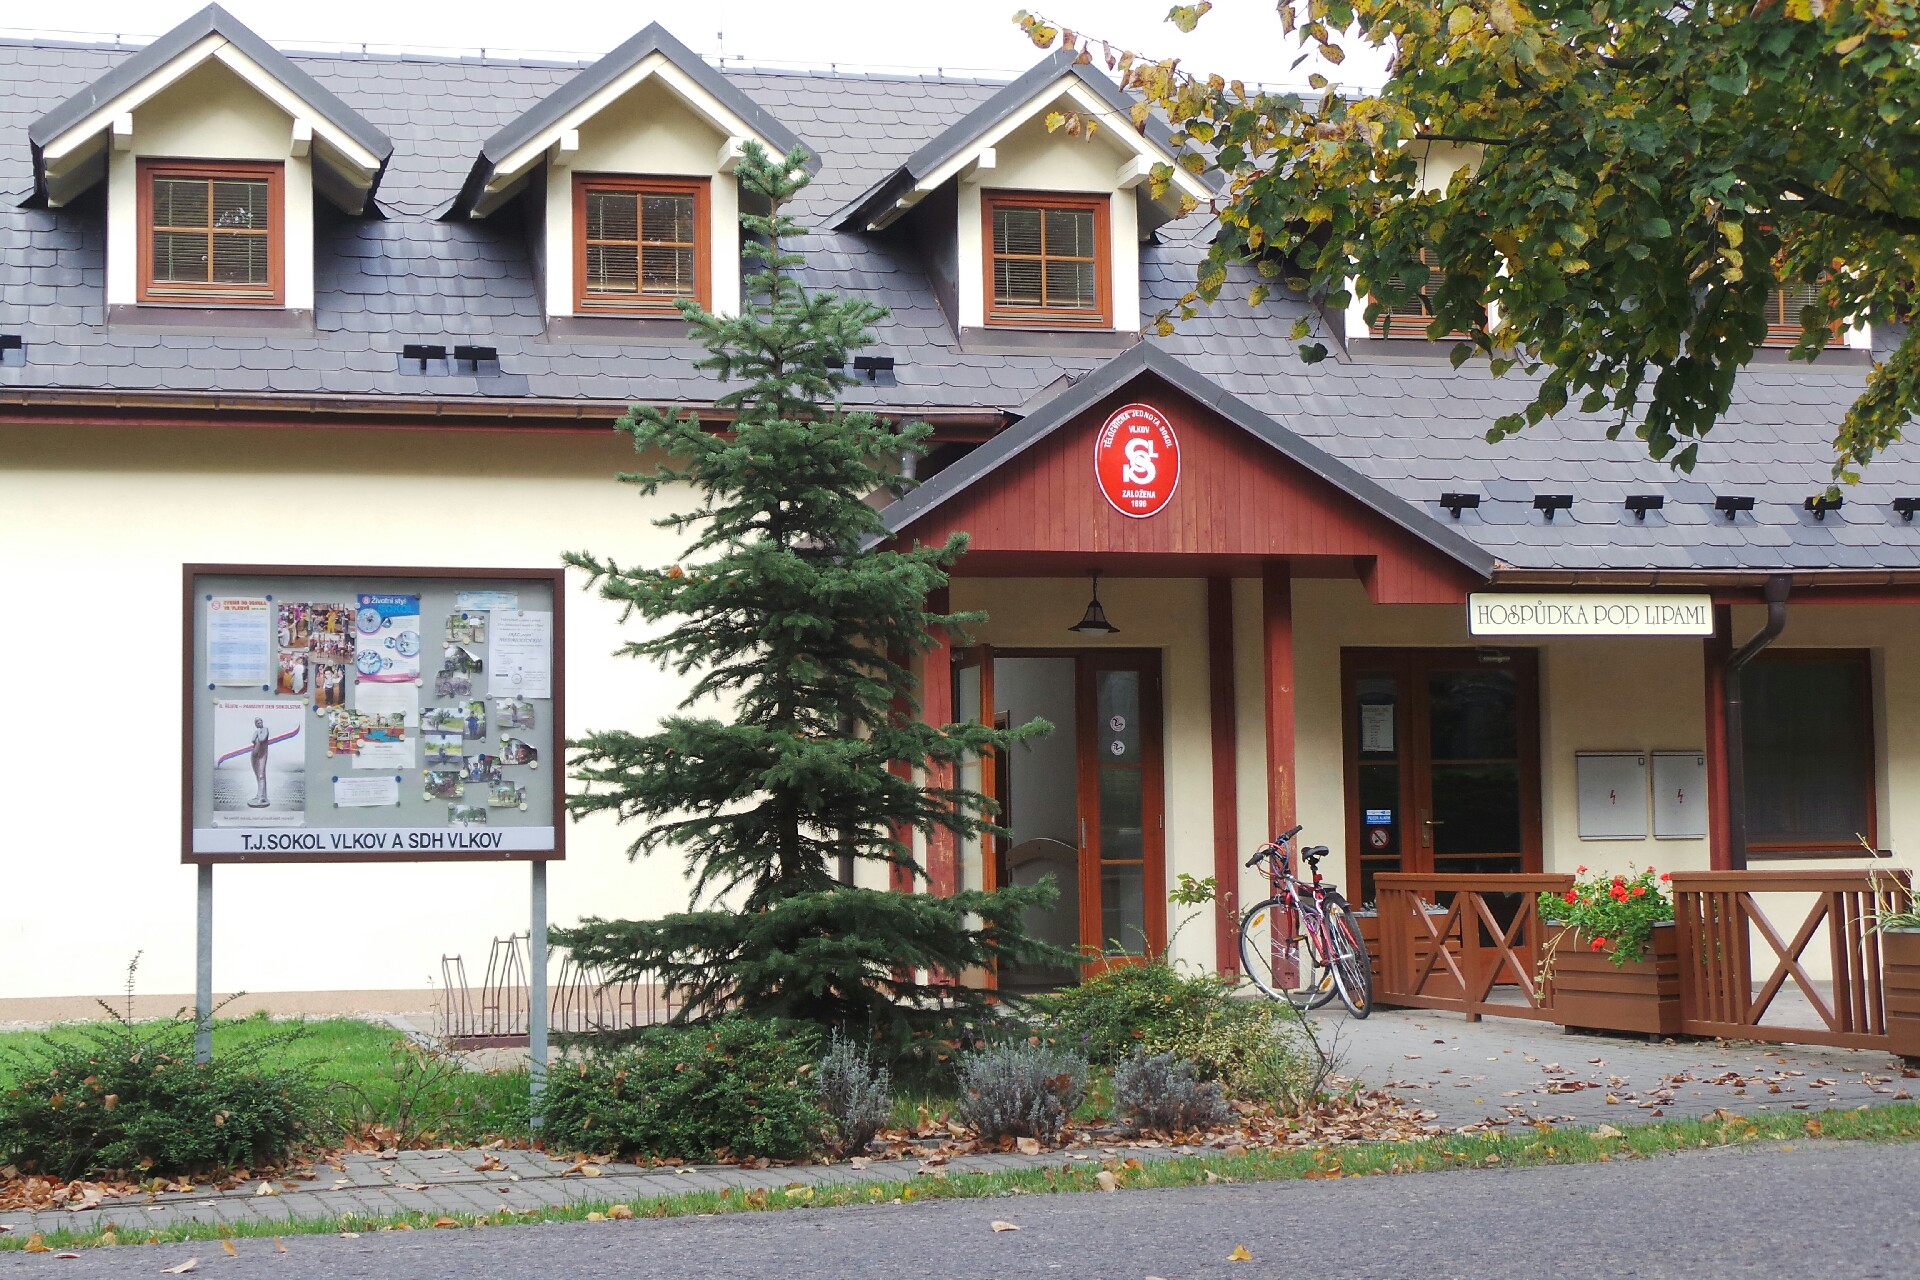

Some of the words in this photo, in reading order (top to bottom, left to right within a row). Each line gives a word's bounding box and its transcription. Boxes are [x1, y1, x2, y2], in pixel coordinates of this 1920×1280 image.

[1128, 425, 1150, 434] VLKOV
[1131, 409, 1161, 427] JEDNOTA
[1159, 425, 1173, 449] SOKOL
[1121, 488, 1156, 499] ZALOŽENA
[1477, 600, 1589, 625] HOSPŮDKA
[1593, 604, 1640, 625] POD
[1644, 604, 1706, 625] LIPAMI
[330, 832, 387, 849] VLKOV
[391, 832, 404, 849] A
[408, 832, 444, 849] SDH
[447, 832, 503, 849] VLKOV
